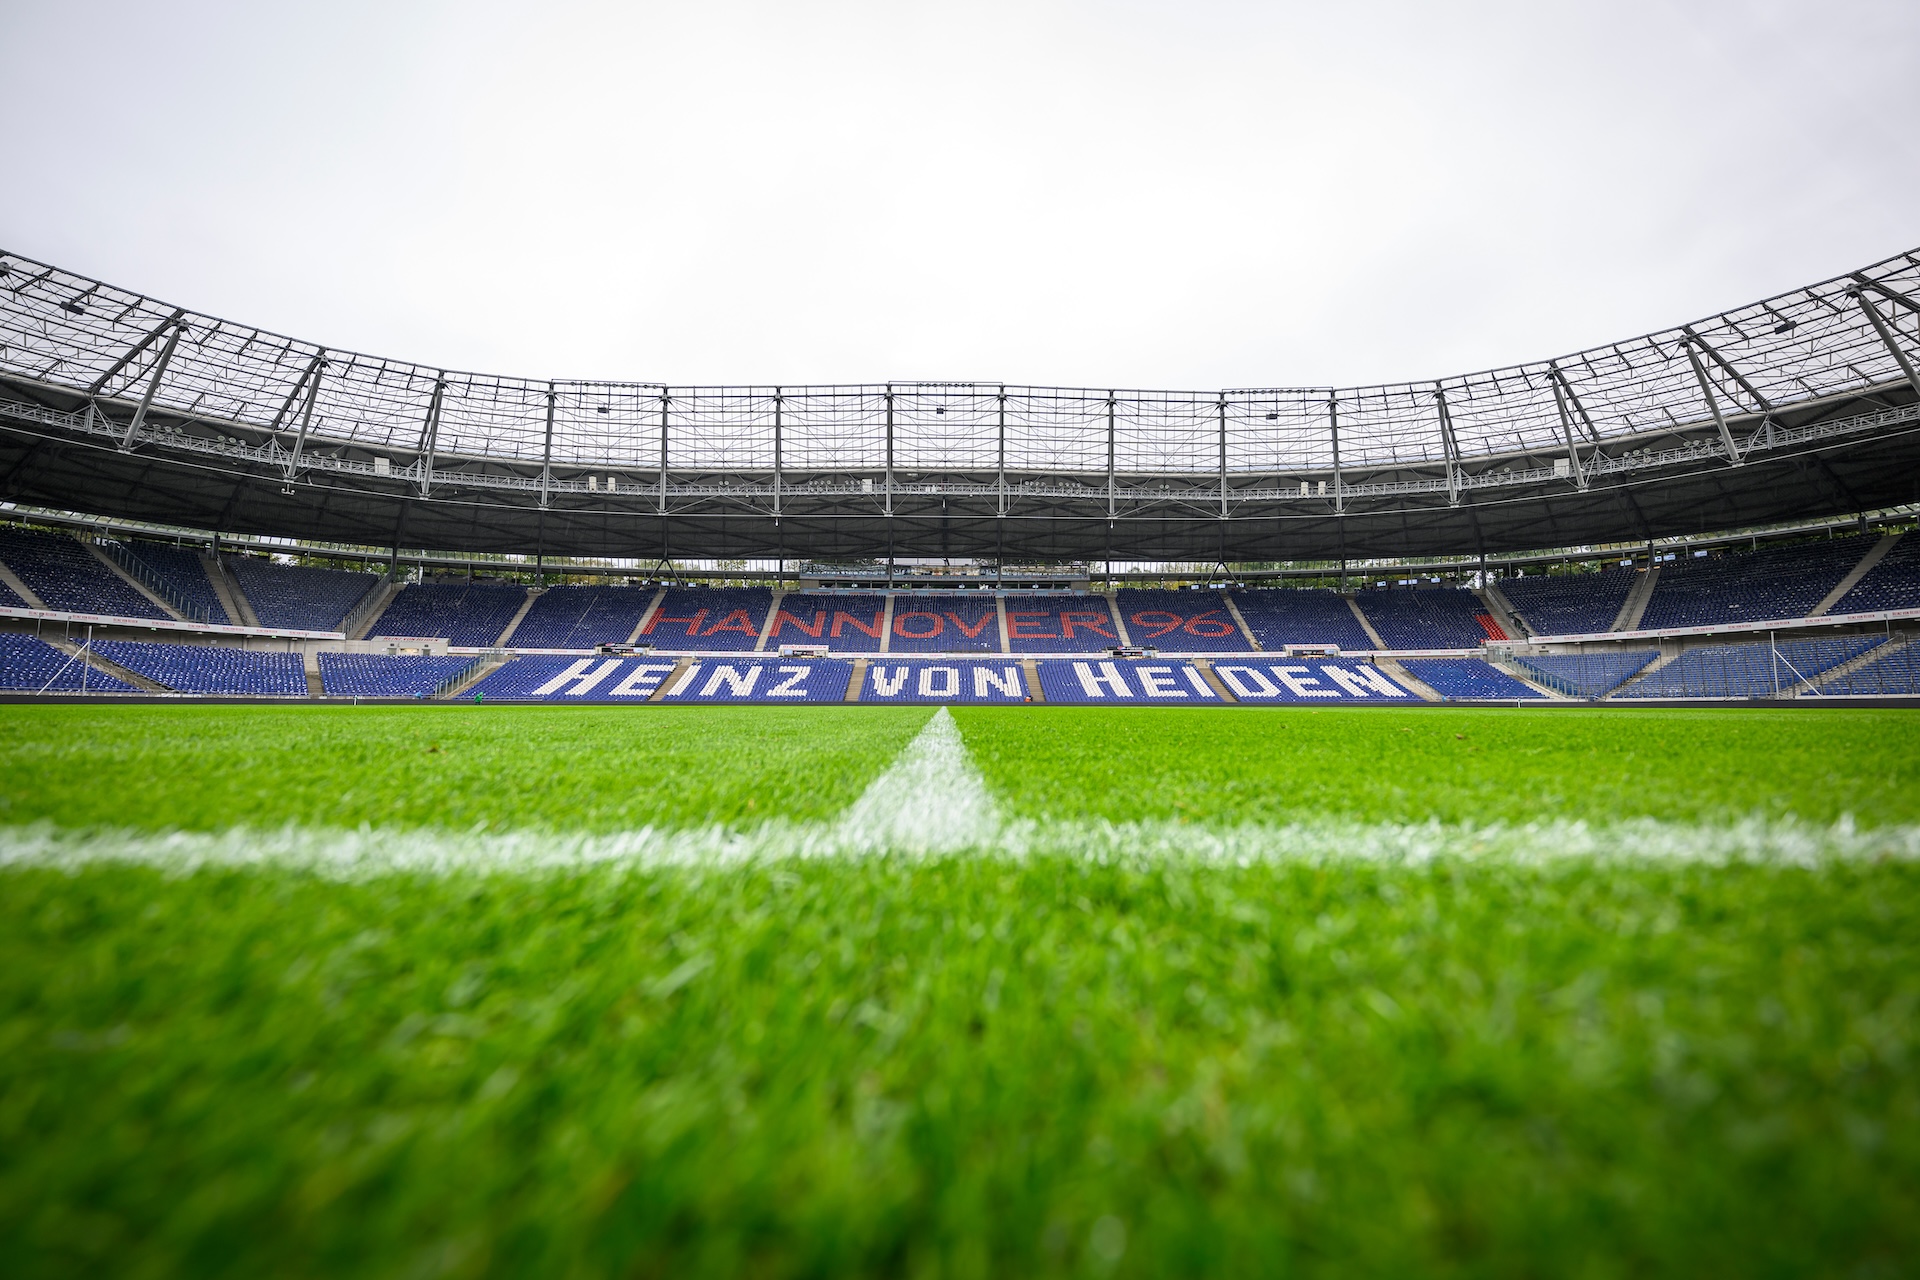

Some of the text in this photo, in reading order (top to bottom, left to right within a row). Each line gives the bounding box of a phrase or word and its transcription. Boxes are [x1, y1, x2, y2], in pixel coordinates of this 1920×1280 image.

[641, 607, 1235, 638] HANNOVER 96
[531, 658, 1407, 697] HEINZ VON HEIDEN
